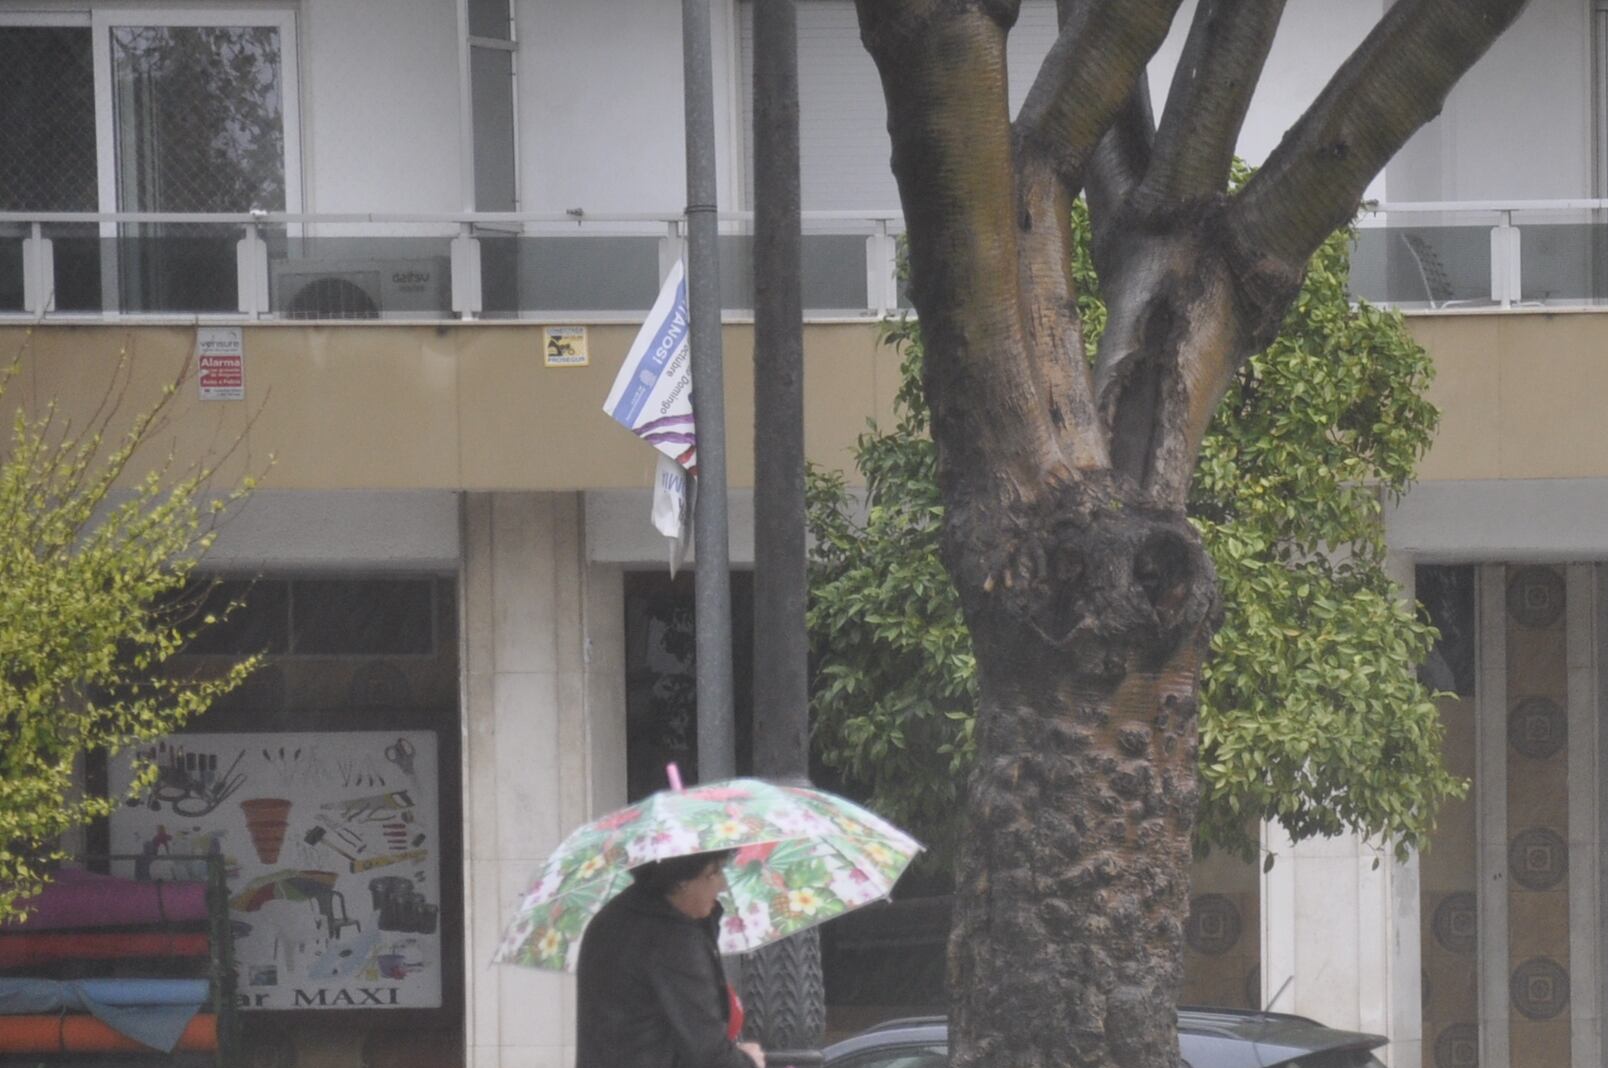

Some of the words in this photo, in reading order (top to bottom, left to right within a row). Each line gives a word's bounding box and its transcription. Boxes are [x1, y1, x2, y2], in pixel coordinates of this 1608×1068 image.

[201, 358, 241, 367] Alarma
[660, 373, 690, 415] Domingo
[293, 988, 399, 1006] MAXI
